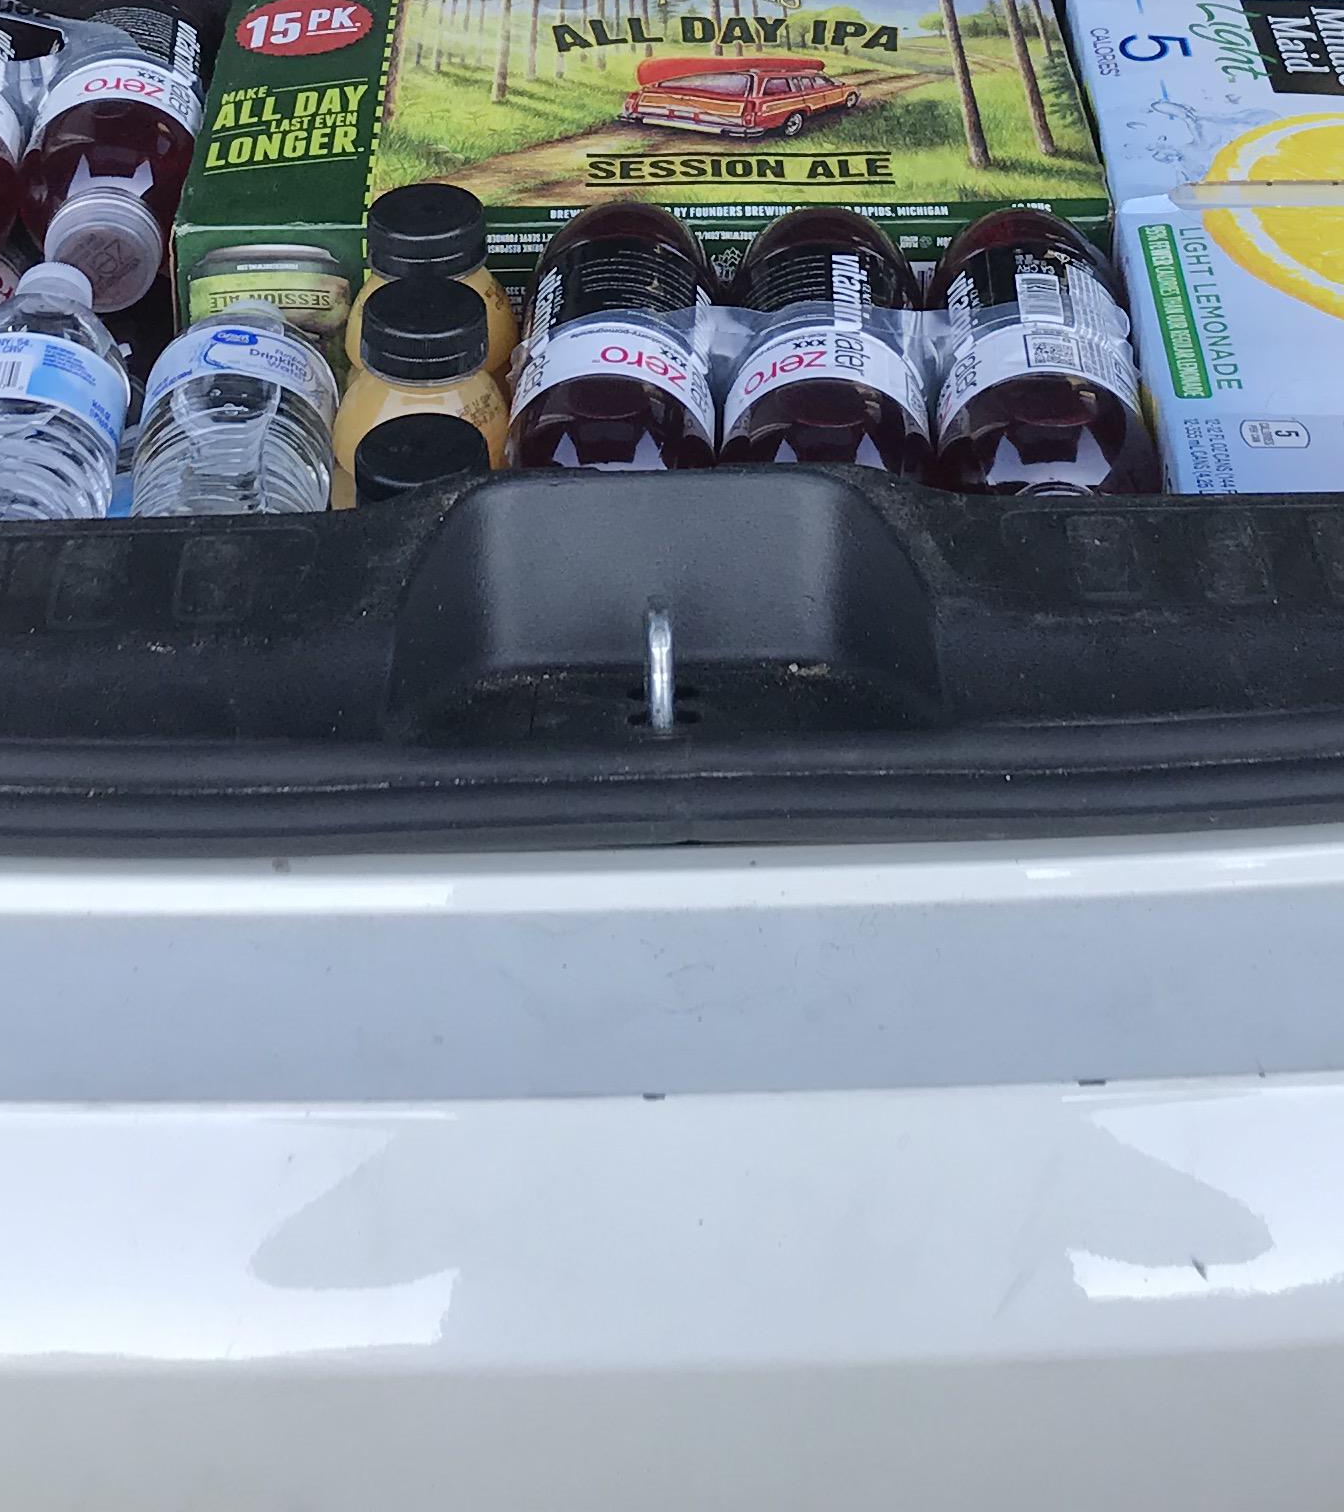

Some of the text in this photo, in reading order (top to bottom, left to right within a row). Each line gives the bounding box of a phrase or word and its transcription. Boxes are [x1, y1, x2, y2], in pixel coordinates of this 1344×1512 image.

[247, 6, 362, 49] 15 PK.
[551, 16, 899, 53] ALL DAY IPA
[1188, 2, 1277, 80] Light
[1119, 34, 1192, 62] 5
[1267, 15, 1330, 74] Maid
[84, 77, 165, 103] zero
[222, 86, 268, 105] MAKE
[212, 85, 368, 131] ALL DAY
[271, 112, 358, 133] LAST EVEN
[206, 126, 365, 168] LONGER.
[586, 157, 894, 181] SESSION ALE
[689, 206, 743, 218] FOUNDERS
[897, 205, 949, 217] MICHIGAN
[1179, 227, 1243, 390] LIGHT LEMONADE
[249, 348, 309, 377] Drinking
[601, 346, 687, 391] zero
[744, 350, 828, 395] zero
[1275, 430, 1299, 438] 5
[1191, 450, 1211, 470] CANS
[1213, 452, 1233, 472] CANS
